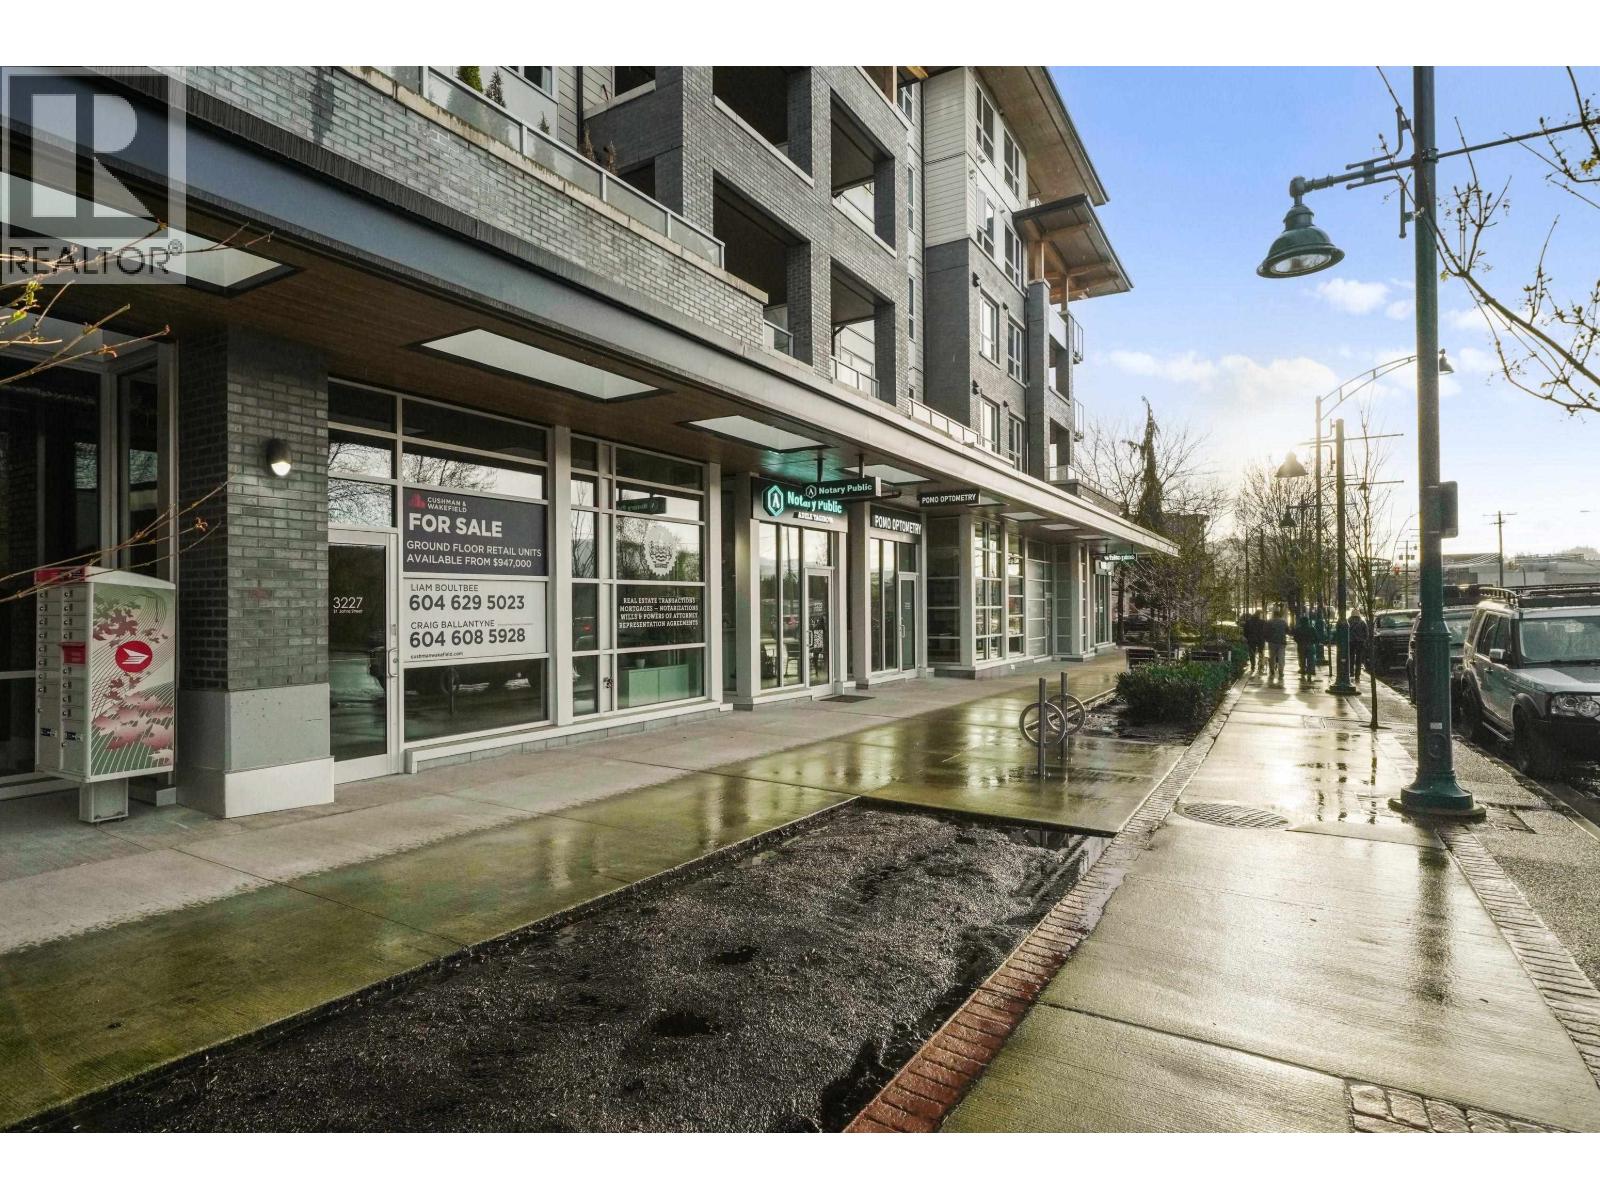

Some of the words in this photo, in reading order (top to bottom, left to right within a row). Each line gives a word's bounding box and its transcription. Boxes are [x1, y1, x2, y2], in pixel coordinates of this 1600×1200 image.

[819, 486, 846, 495] Notary
[847, 483, 873, 492] Public
[427, 496, 461, 507] CUSHMAN
[922, 496, 939, 504] POMO
[940, 493, 977, 503] OPTOMETRY
[427, 503, 467, 513] WAKEFIELD
[818, 500, 843, 514] Public
[409, 513, 450, 533] FOR
[455, 517, 503, 537] SALE
[874, 514, 892, 530] POMO
[892, 518, 922, 535] OPTOMETRY
[406, 540, 450, 551] GROUND
[452, 543, 485, 554] FLOOR
[486, 546, 517, 556] RETAIL
[518, 548, 542, 557] UNITS
[406, 553, 462, 565] AVAILABLE
[465, 556, 491, 566] FROM
[493, 558, 532, 569] $947,000
[410, 584, 433, 592] LIAM
[435, 584, 479, 592] BOULTBEE
[333, 596, 363, 609] 3227
[409, 594, 446, 611] 604
[450, 595, 482, 610] 629
[486, 595, 525, 610] 5023
[643, 612, 665, 620] POWERS
[673, 611, 699, 619] ATTORNEY
[410, 621, 439, 630] CRAIG
[441, 619, 495, 629] BALLANTYNE
[618, 620, 666, 629] REPRESENTATION
[666, 619, 699, 627] AGREEMENTS
[409, 631, 446, 648] 604
[451, 629, 484, 646] 608
[488, 628, 526, 643] 5928
